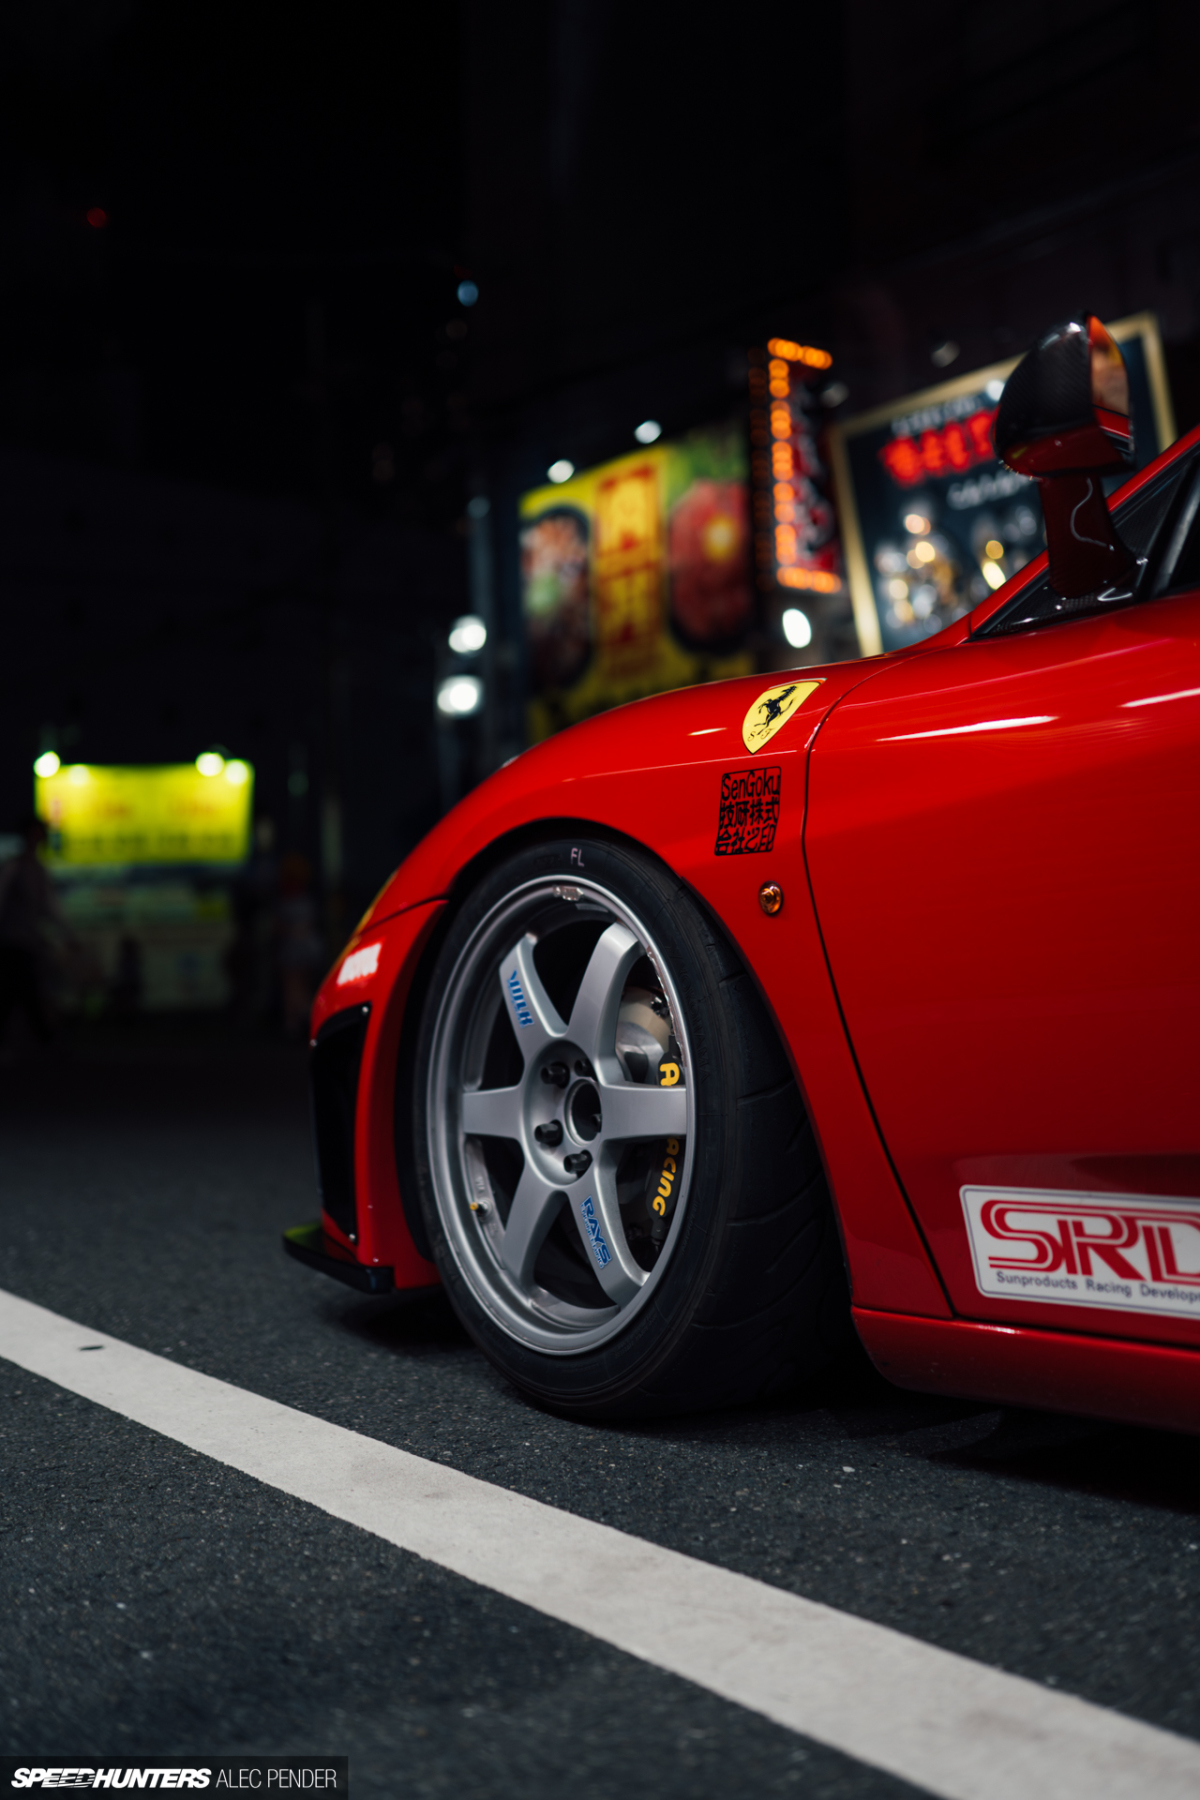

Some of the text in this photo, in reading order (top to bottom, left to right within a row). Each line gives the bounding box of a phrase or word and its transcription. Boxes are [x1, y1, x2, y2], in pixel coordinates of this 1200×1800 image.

[721, 768, 780, 800] SenGoku
[719, 796, 779, 829] 技研株式
[570, 847, 585, 868] FL
[584, 1196, 611, 1264] RAYS
[982, 1200, 1200, 1285] SRD
[996, 1270, 1200, 1304] Sunproducts Racing Develop
